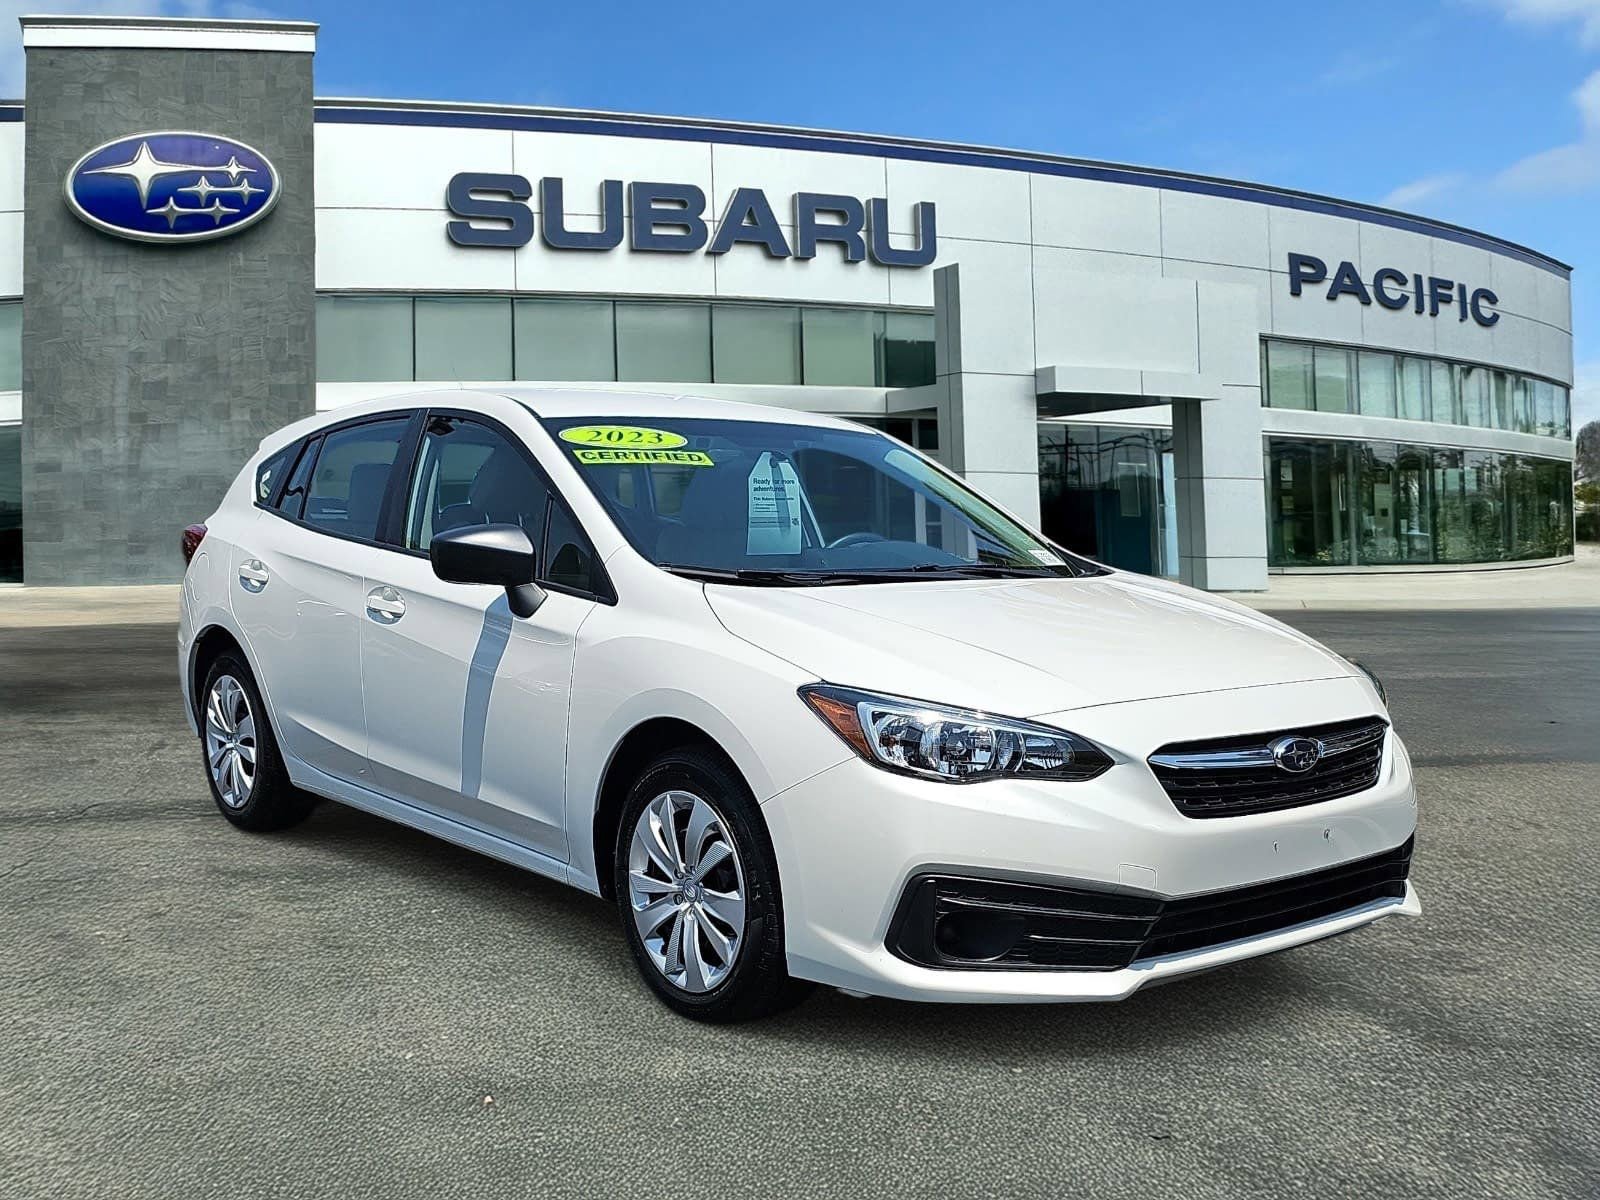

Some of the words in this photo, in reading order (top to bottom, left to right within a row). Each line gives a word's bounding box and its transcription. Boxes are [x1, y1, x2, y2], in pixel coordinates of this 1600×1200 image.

[447, 172, 937, 267] SUBARU
[1288, 252, 1500, 327] PACIFIC
[580, 451, 703, 463] CERTIFIED
[586, 430, 664, 444] 2023
